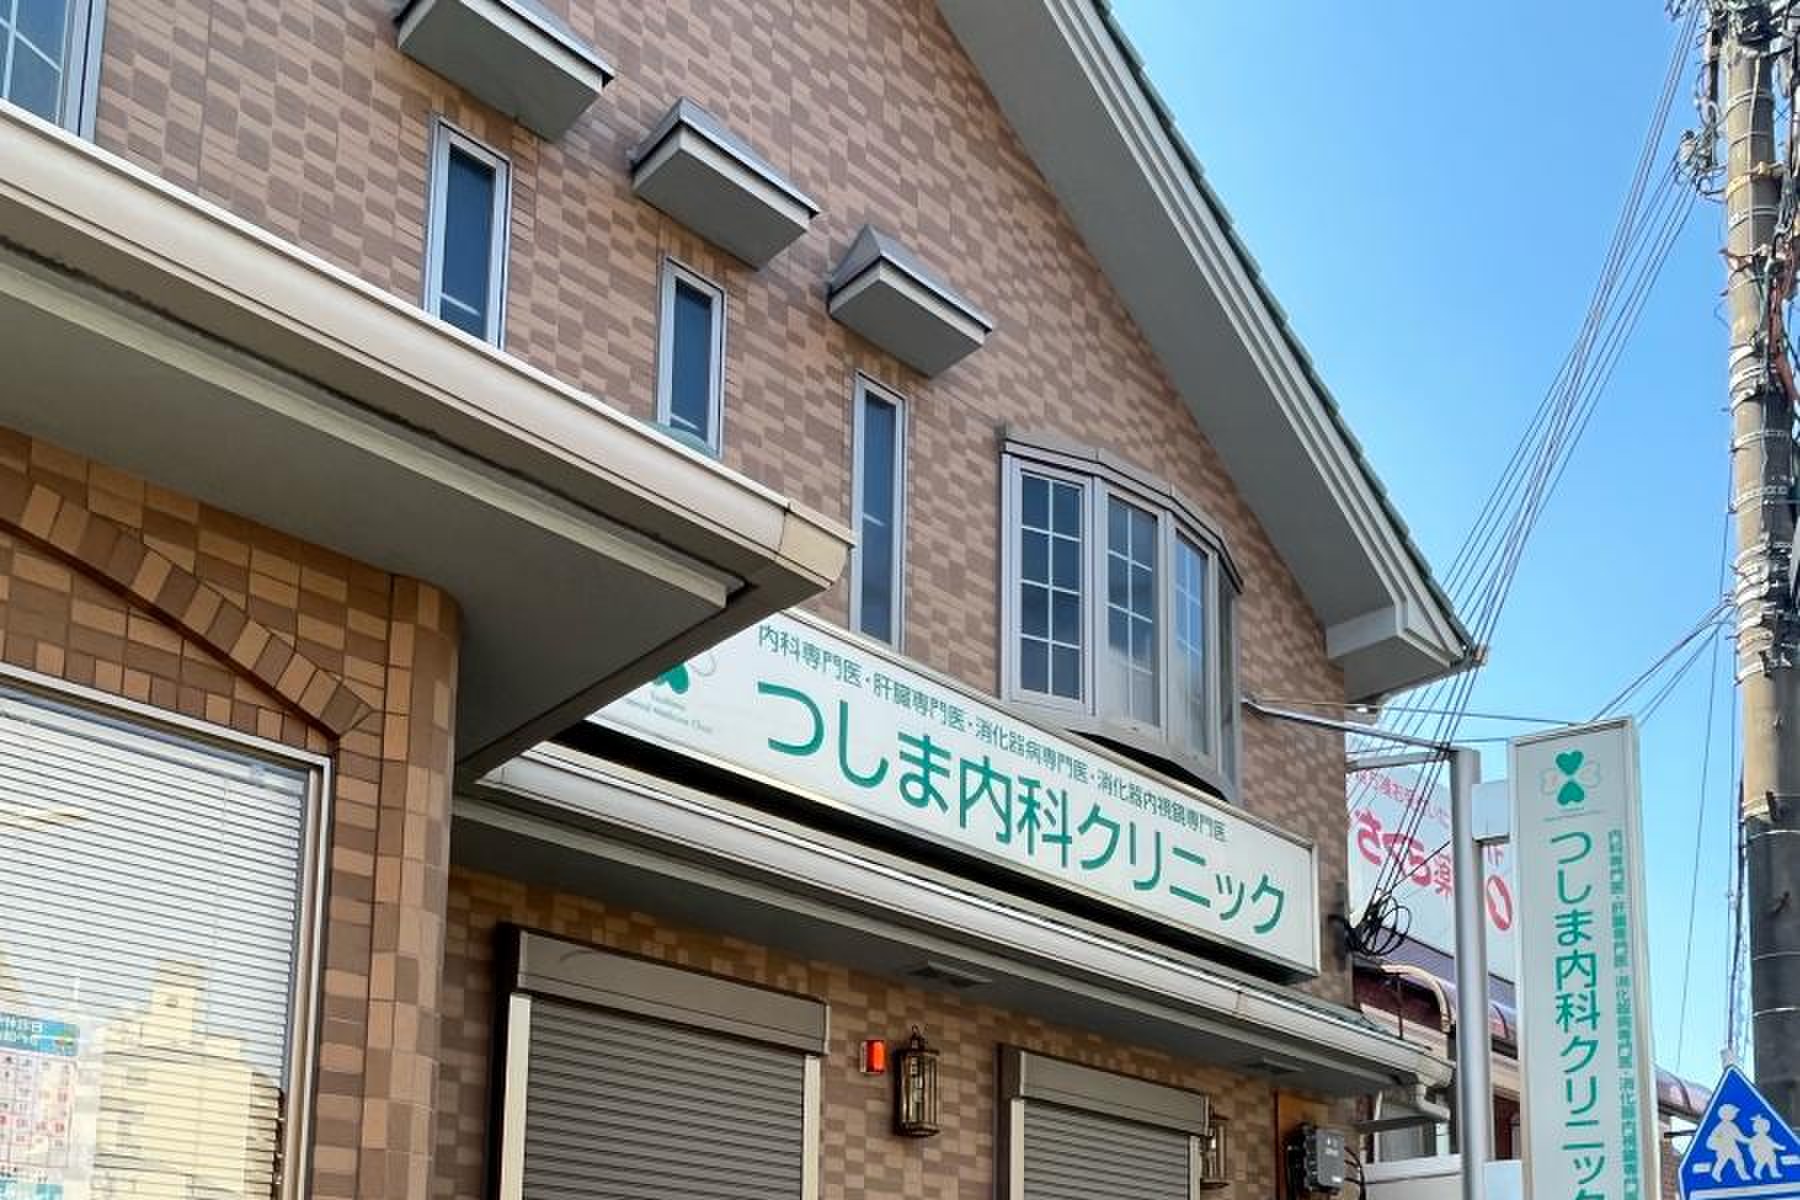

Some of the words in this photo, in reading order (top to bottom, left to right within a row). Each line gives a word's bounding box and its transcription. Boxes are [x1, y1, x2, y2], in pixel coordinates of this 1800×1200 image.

[756, 680, 1285, 934] つしま内科クリニック
